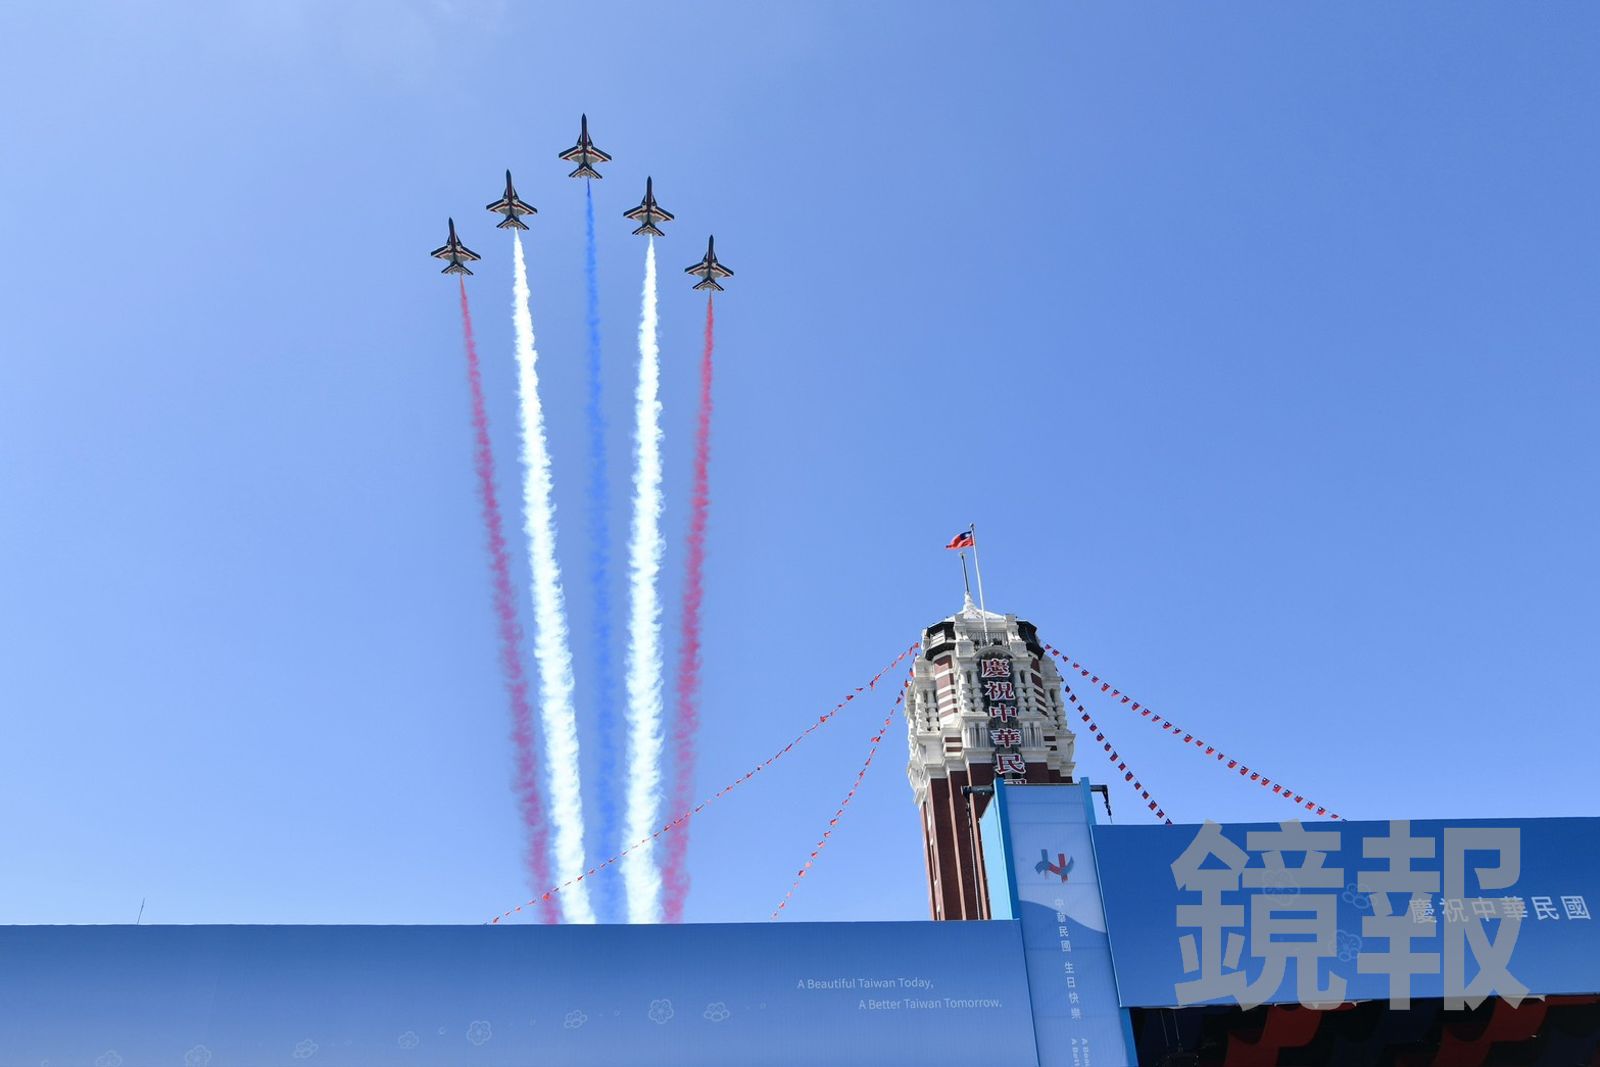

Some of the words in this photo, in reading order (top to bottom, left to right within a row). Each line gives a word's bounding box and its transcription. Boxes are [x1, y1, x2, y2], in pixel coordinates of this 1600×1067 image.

[981, 658, 1027, 784] 慶祝中華民
[1409, 895, 1592, 924] 慶祝中華民國
[797, 979, 805, 989] A
[807, 978, 856, 989] Beautiful
[857, 978, 896, 989] Taiwan
[898, 977, 934, 990] Today,
[858, 1000, 867, 1010] A
[868, 999, 901, 1010] Better
[904, 998, 942, 1009] Taiwan
[944, 998, 1003, 1008] Tomorrow.
